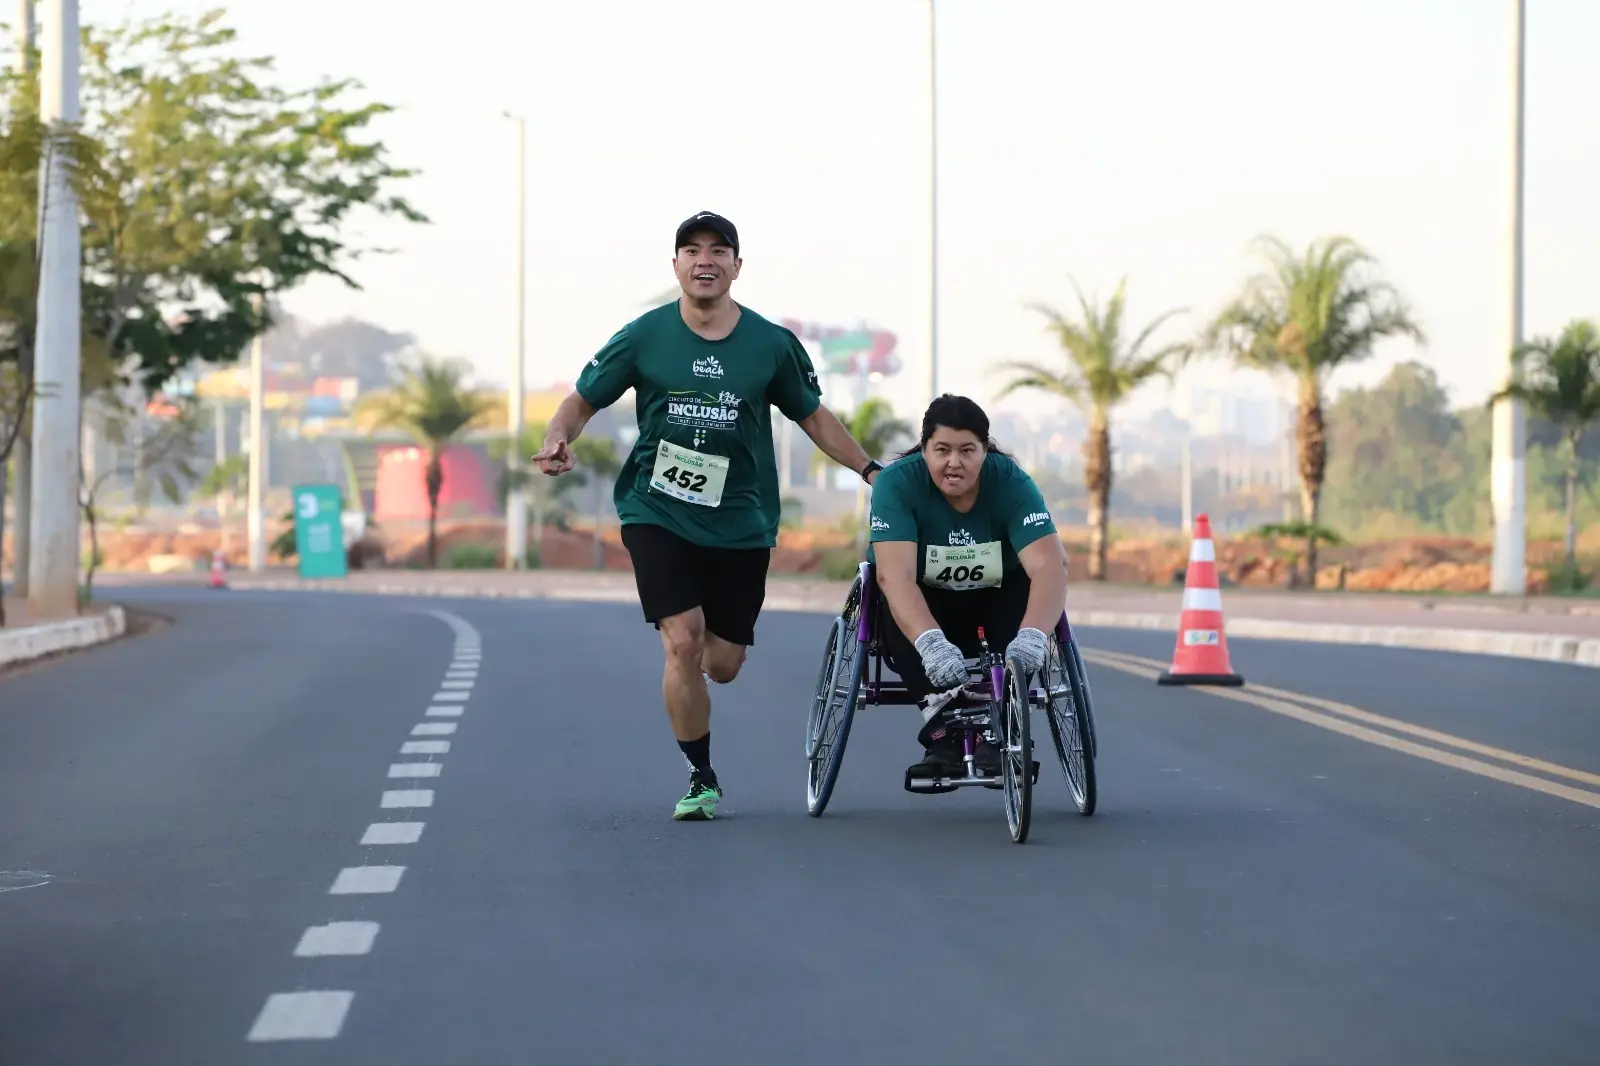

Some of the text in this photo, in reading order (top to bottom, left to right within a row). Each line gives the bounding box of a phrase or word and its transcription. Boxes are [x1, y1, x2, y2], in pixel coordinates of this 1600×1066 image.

[692, 360, 725, 376] beach
[696, 358, 708, 366] hot
[667, 402, 739, 421] INCLUSÃO
[677, 418, 705, 426] INSTITUTO
[662, 465, 708, 493] 452
[299, 492, 319, 519] 3
[948, 532, 977, 546] beach
[936, 565, 984, 582] 406
